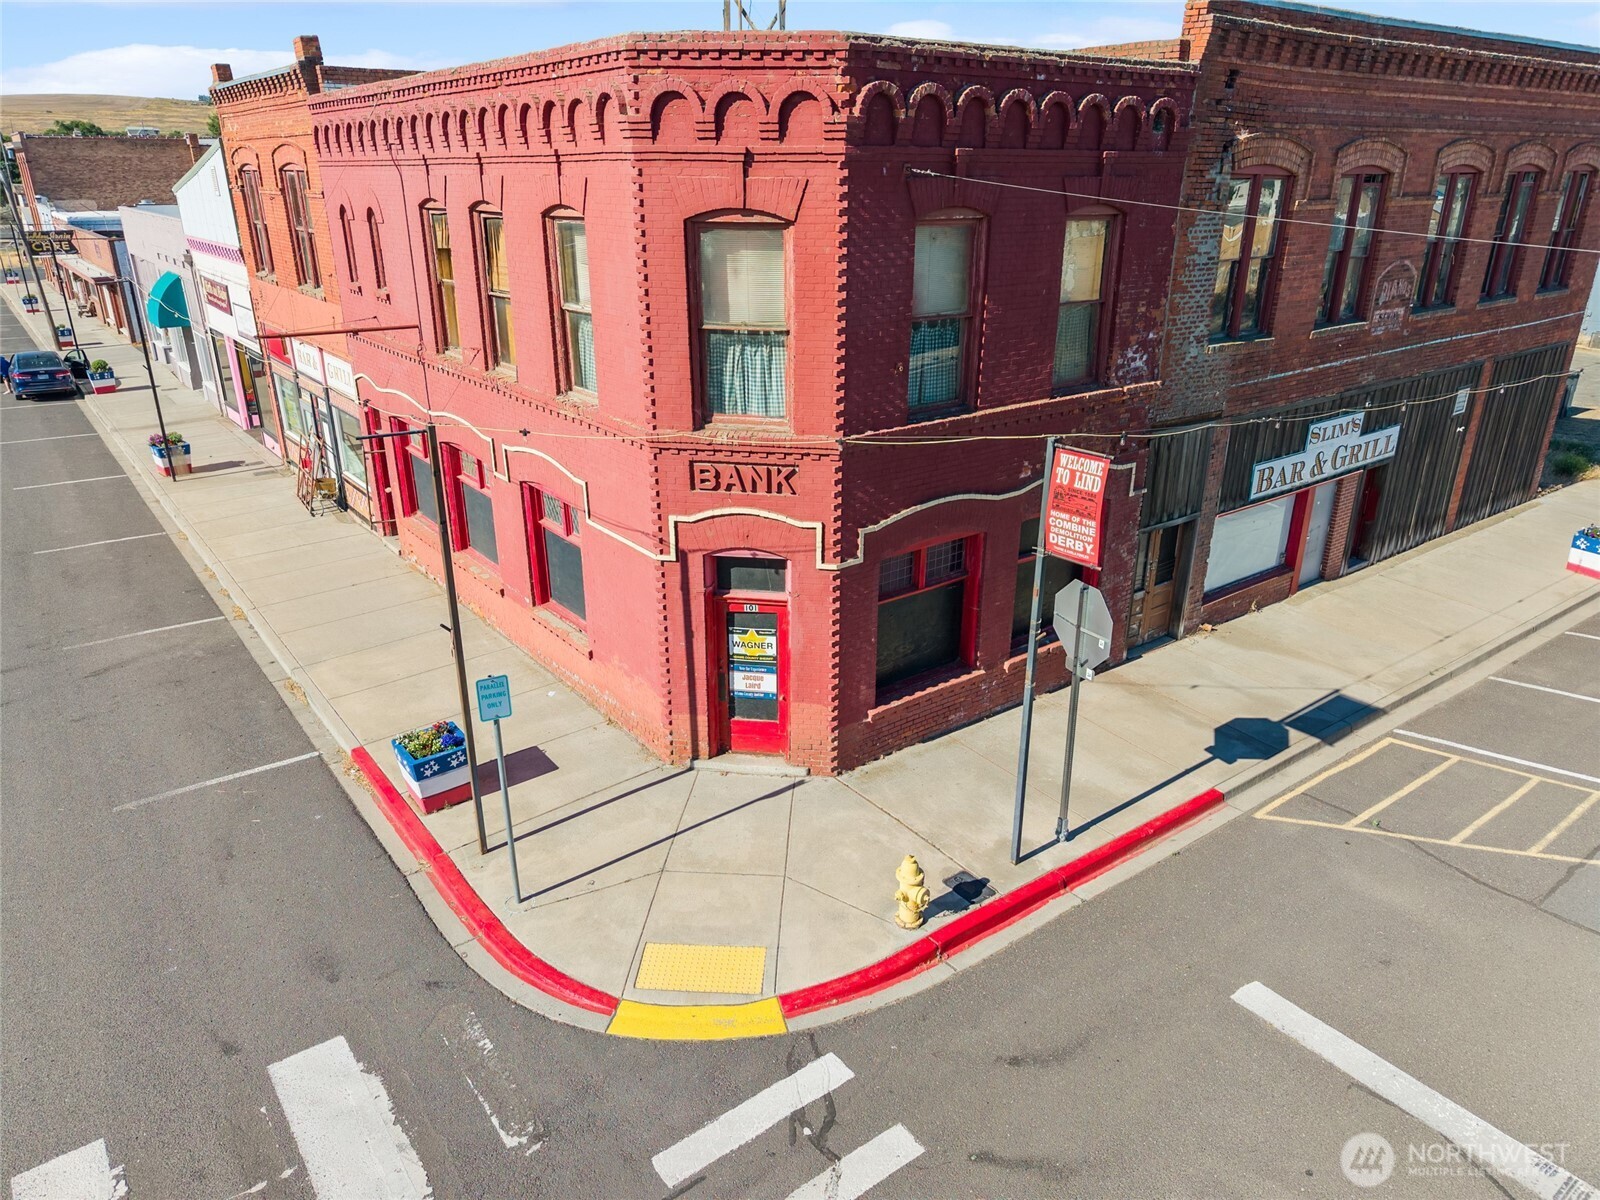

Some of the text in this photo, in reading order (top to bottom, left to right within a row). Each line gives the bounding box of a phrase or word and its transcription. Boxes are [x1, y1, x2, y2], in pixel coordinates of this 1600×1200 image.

[31, 240, 70, 251] CAFE
[1309, 417, 1362, 445] SLIM'S
[1060, 453, 1105, 476] WELCOME
[1253, 434, 1395, 495] BAR & GRILL
[695, 463, 800, 495] BANK
[1056, 467, 1101, 493] TO LIND
[1049, 518, 1096, 536] COMBINE
[1050, 509, 1096, 527] HOME OF THE
[1049, 533, 1094, 554] DERBY
[1050, 527, 1093, 543] DEMOLITION
[732, 640, 773, 650] WAGNER
[480, 681, 505, 691] PARALLEL
[742, 674, 764, 682] Jacque
[481, 691, 506, 700] PARKING
[487, 701, 503, 709] ONLY
